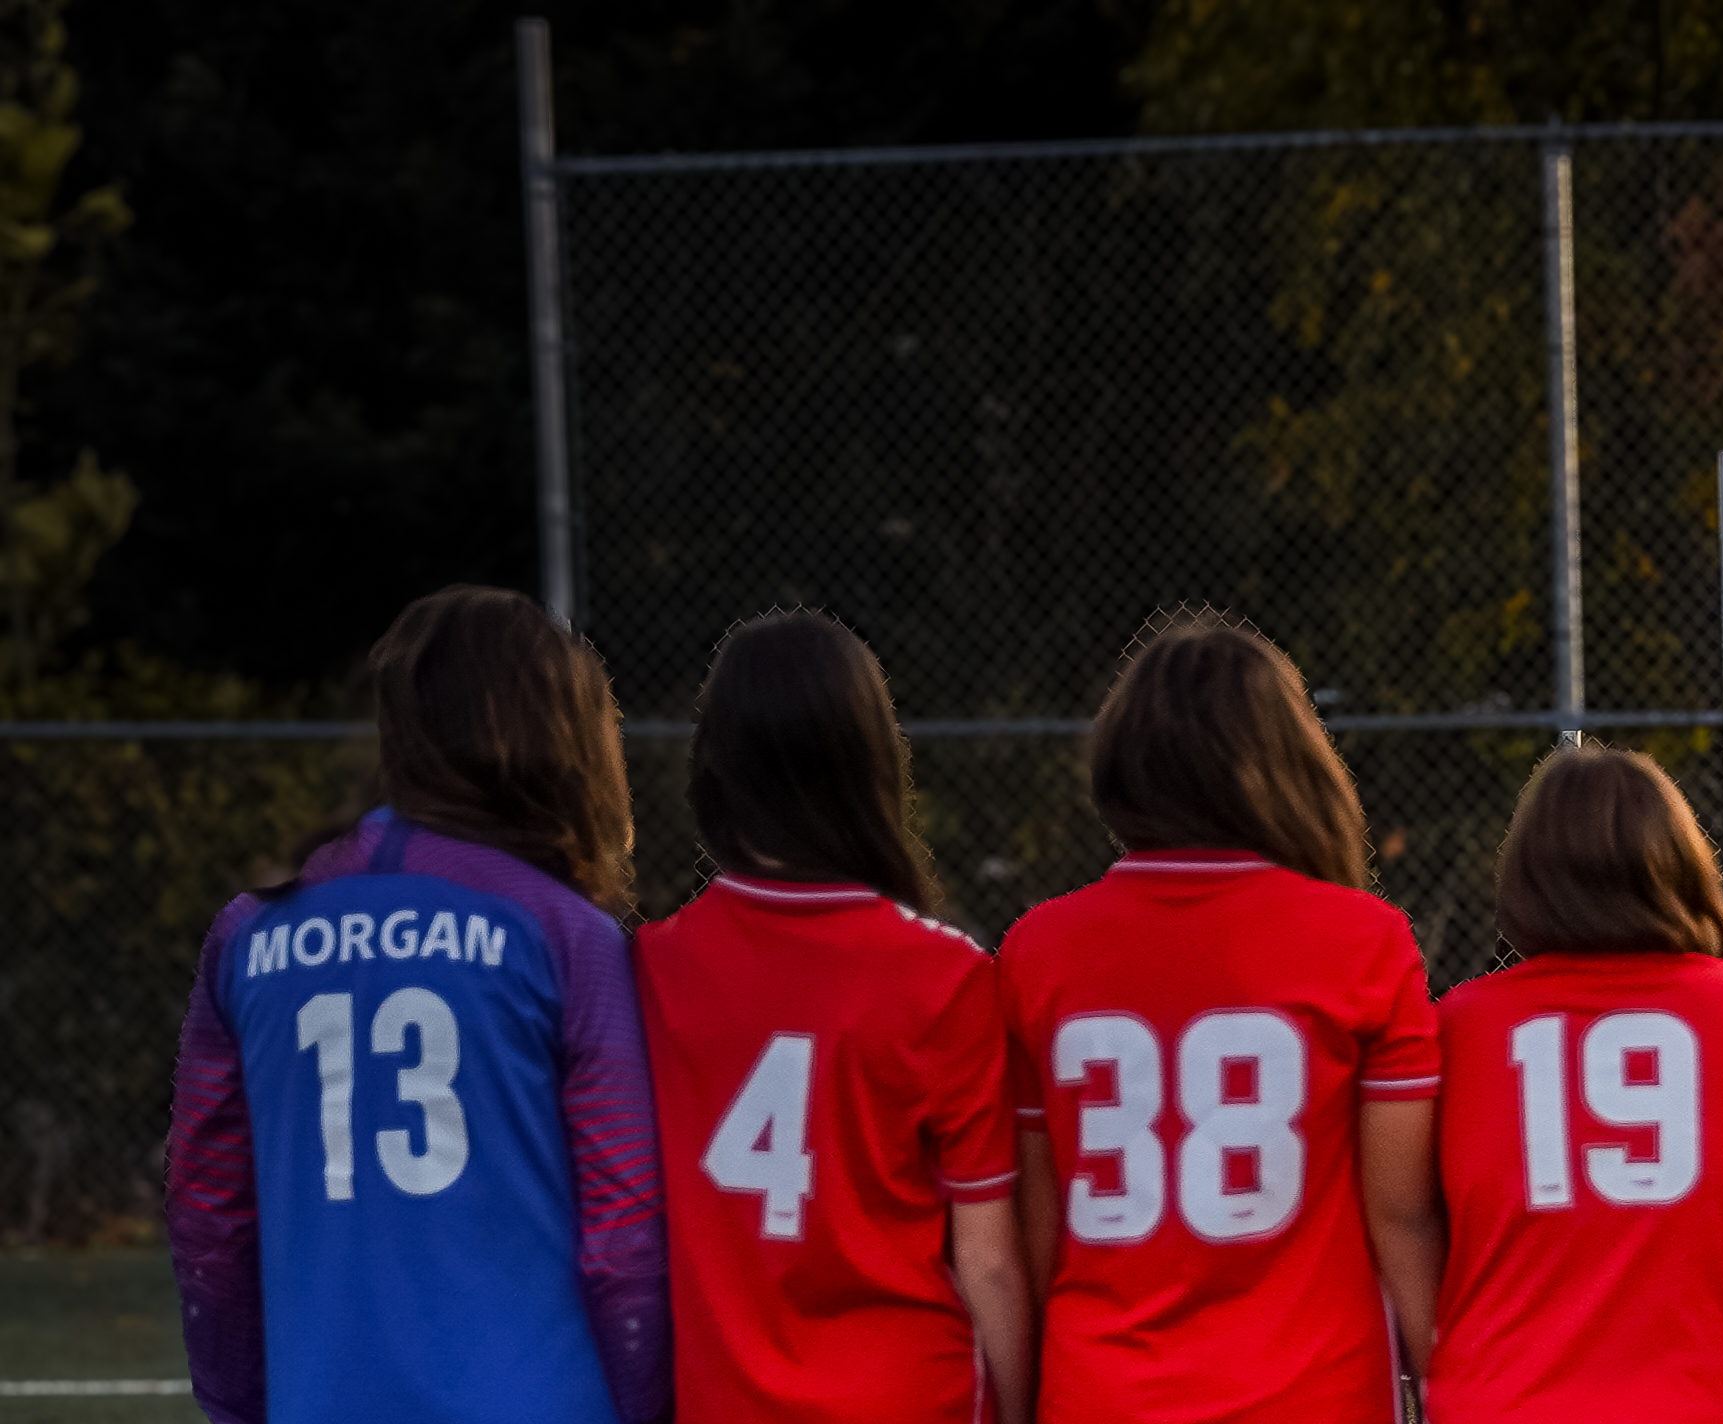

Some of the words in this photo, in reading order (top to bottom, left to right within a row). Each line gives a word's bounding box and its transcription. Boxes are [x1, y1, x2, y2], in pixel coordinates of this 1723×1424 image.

[248, 908, 506, 977] MORGAN
[296, 986, 470, 1201] 13
[701, 1032, 813, 1241] 4
[1051, 1009, 1308, 1242] 38
[1510, 1009, 1702, 1210] 19
